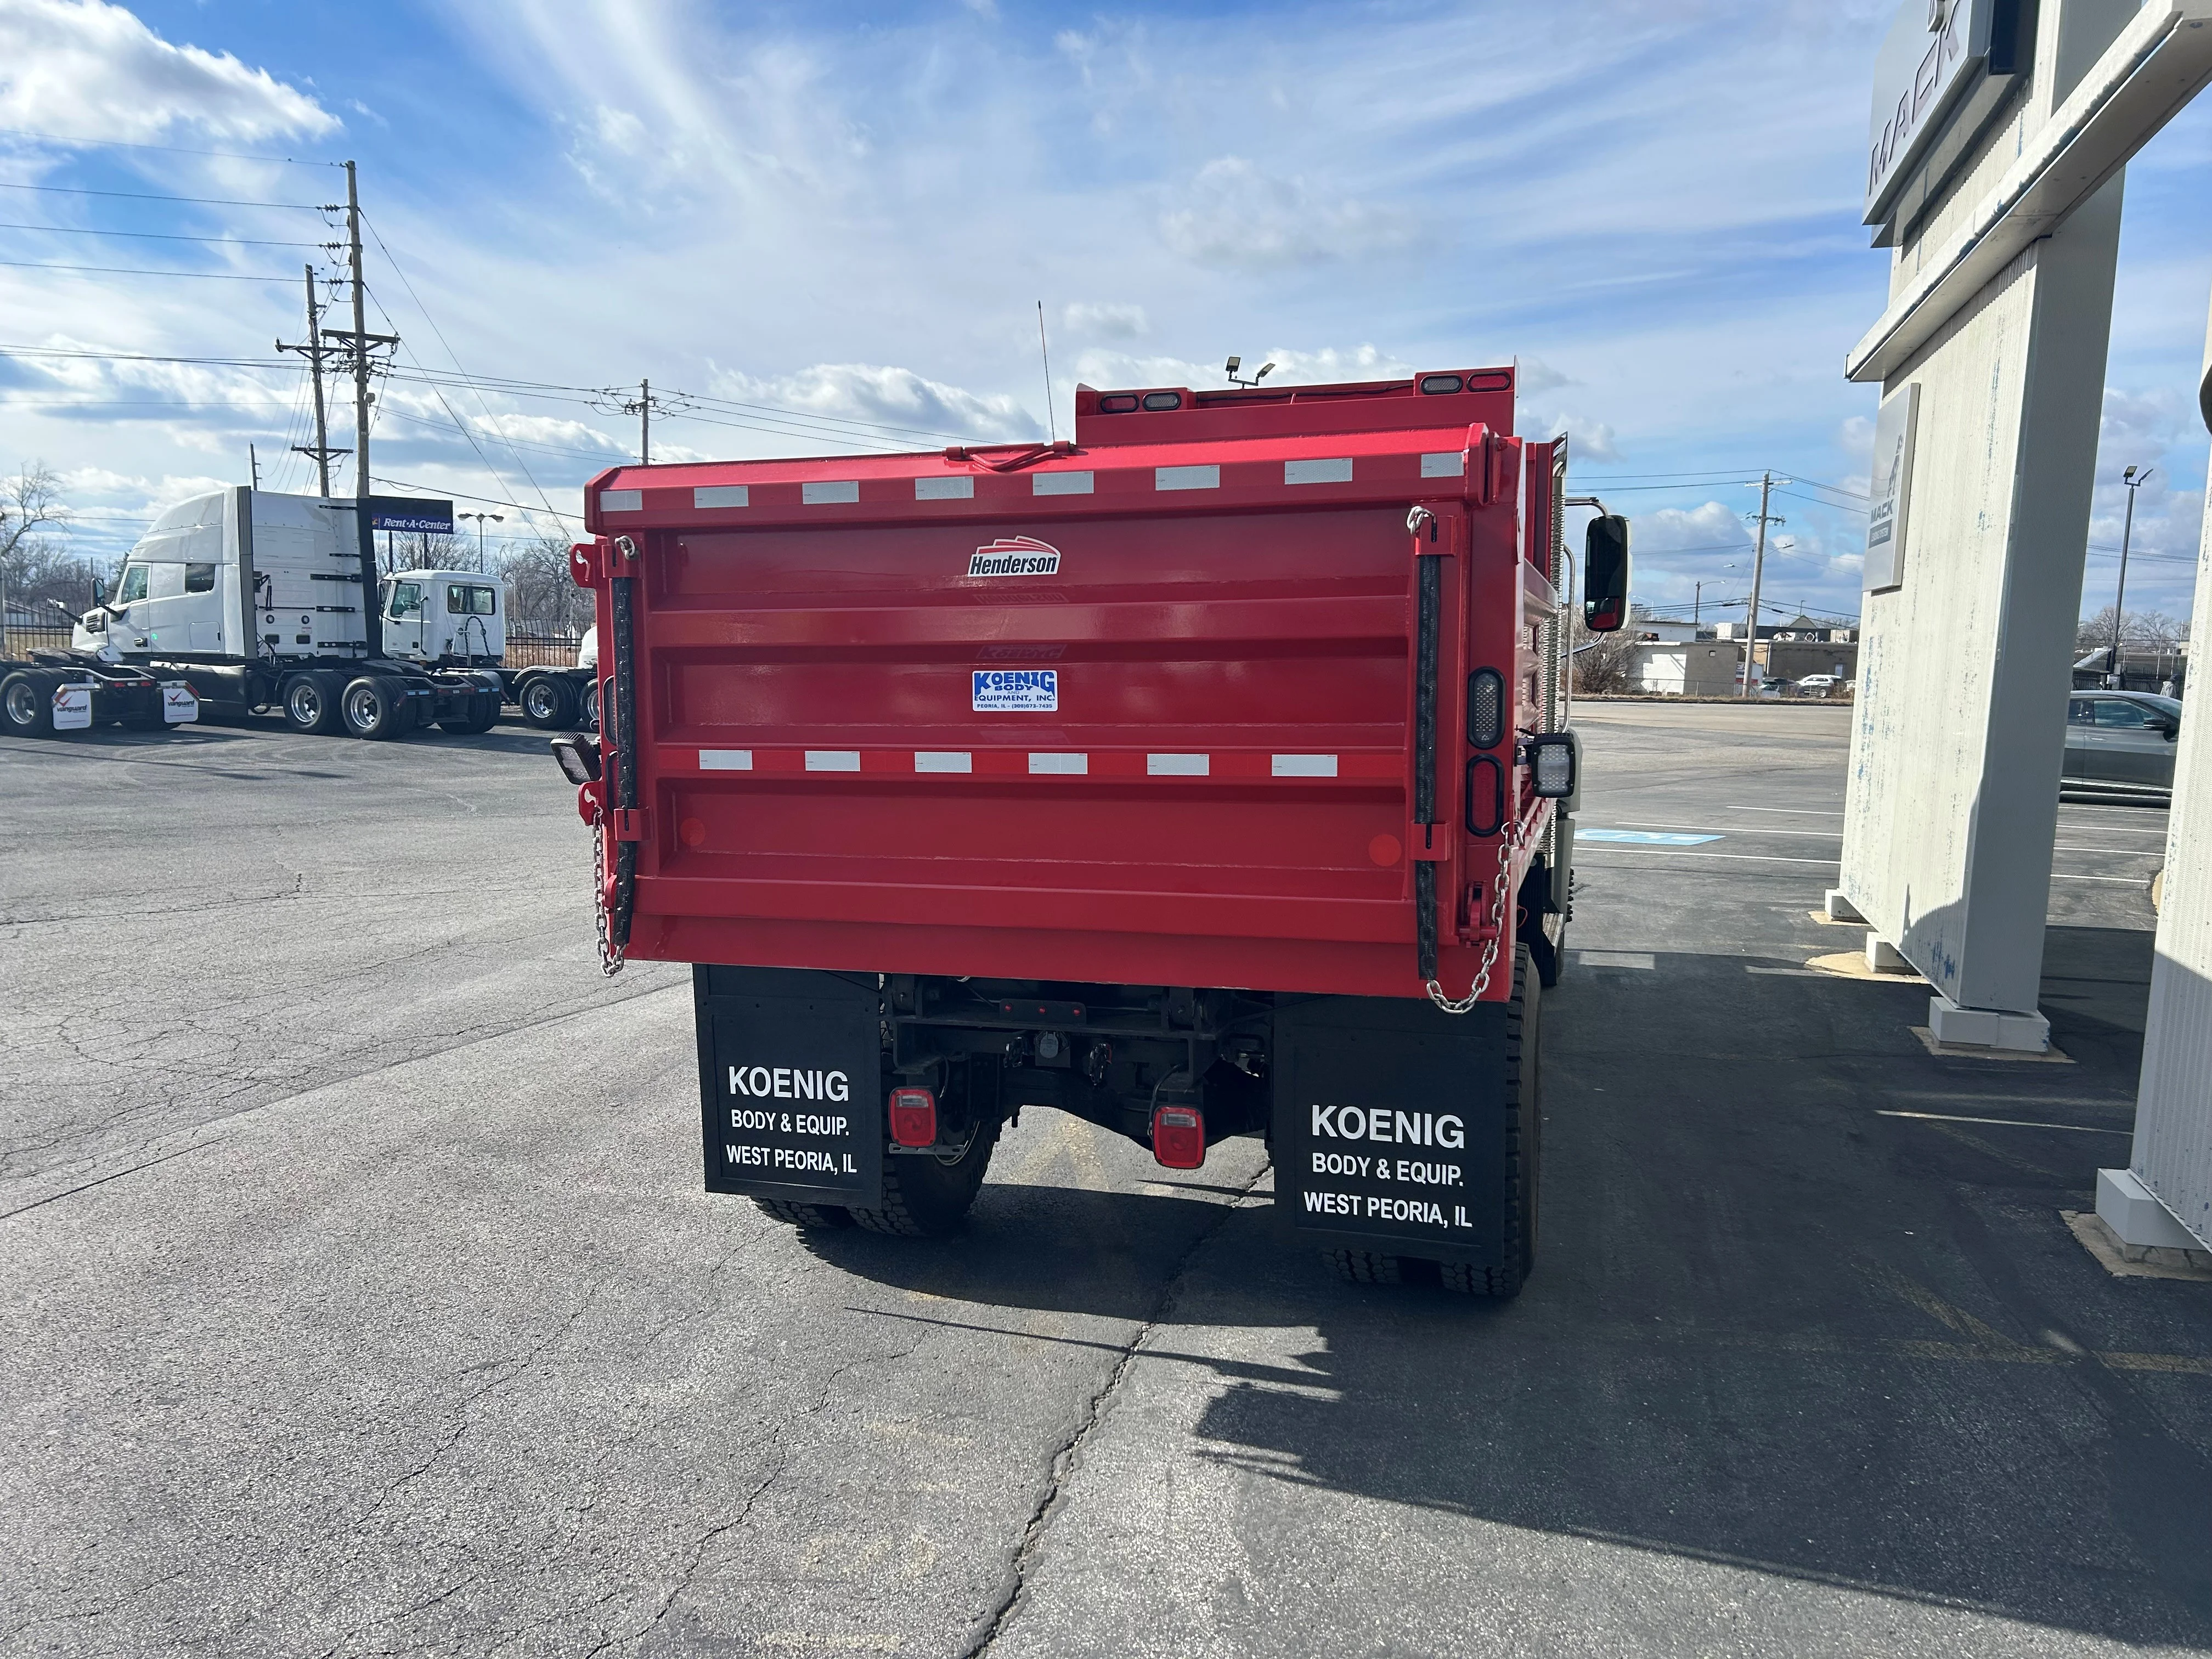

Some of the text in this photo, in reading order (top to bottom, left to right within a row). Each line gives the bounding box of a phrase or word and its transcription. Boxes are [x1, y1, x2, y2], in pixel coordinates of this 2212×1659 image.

[1869, 0, 1961, 197] MACK
[1870, 499, 1894, 524] MACK
[970, 555, 1057, 574] Henderson
[974, 672, 1056, 697] KOENIG
[729, 1066, 849, 1102] KOENIG
[731, 1109, 849, 1136] BODY & EQUIP.
[1312, 1104, 1464, 1149] KOENIG
[726, 1144, 857, 1175] WEST PEORIA, IL
[1312, 1152, 1464, 1186] BODY & EQUIP.
[1304, 1191, 1472, 1228] WEST PEORIA, IL
